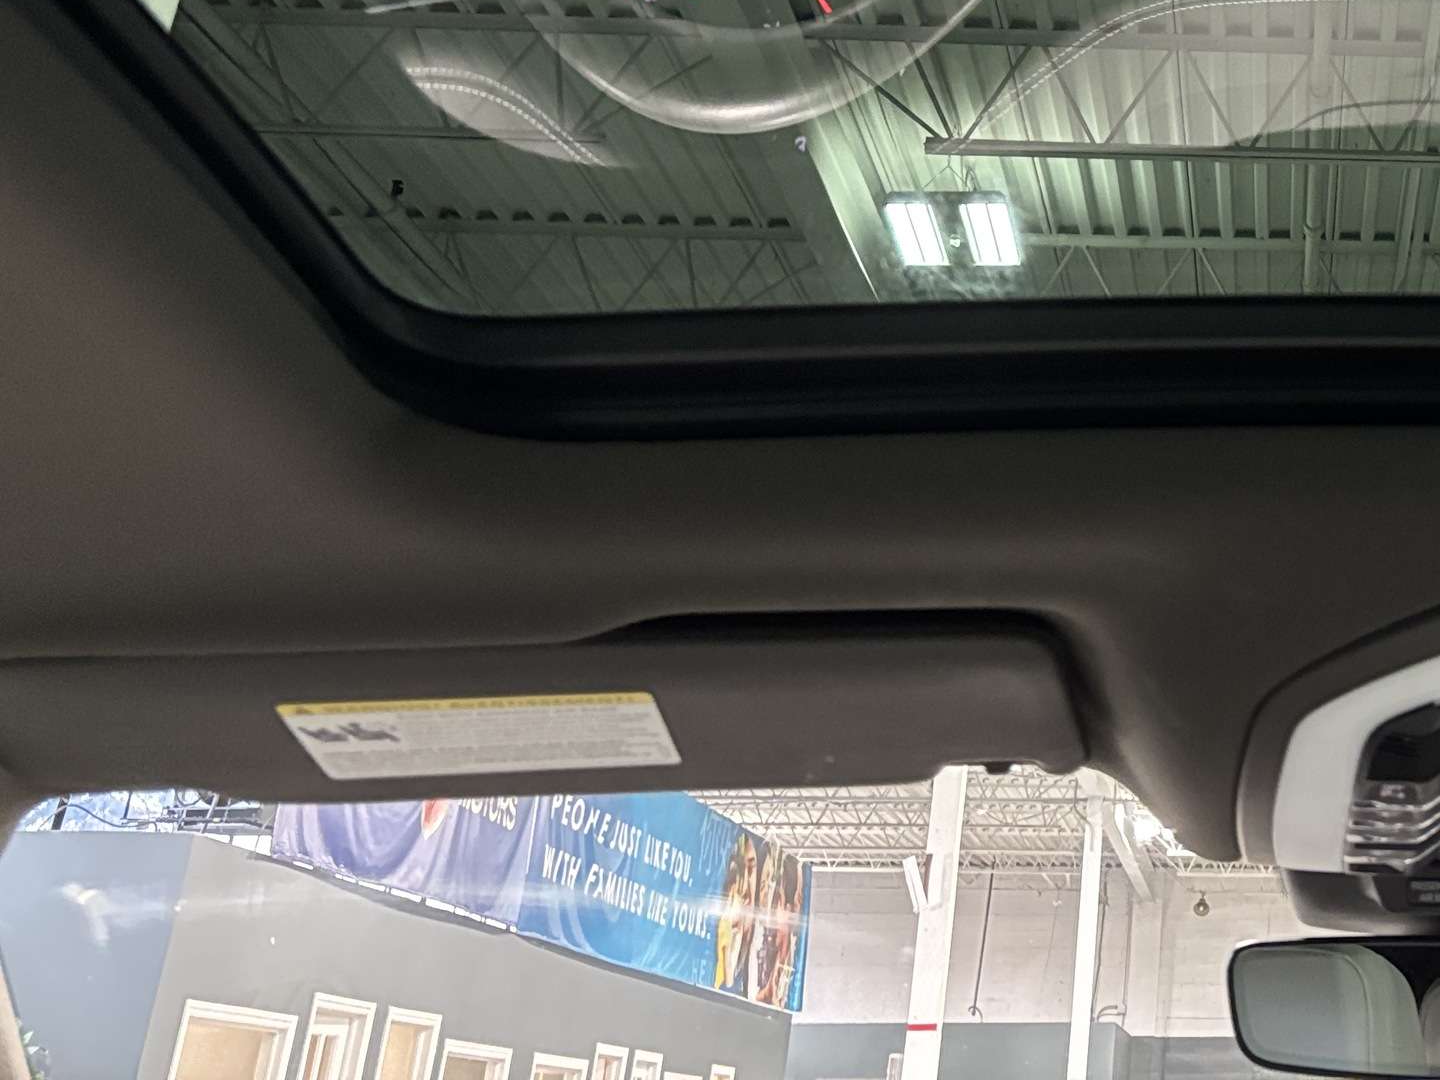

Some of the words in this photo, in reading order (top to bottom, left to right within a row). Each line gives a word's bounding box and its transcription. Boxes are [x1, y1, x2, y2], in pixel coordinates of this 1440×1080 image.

[609, 819, 643, 859] JUST
[644, 833, 670, 871] LIKE
[542, 844, 582, 891] WITH
[584, 863, 645, 917] FAMILIES
[647, 889, 669, 926] LIKE
